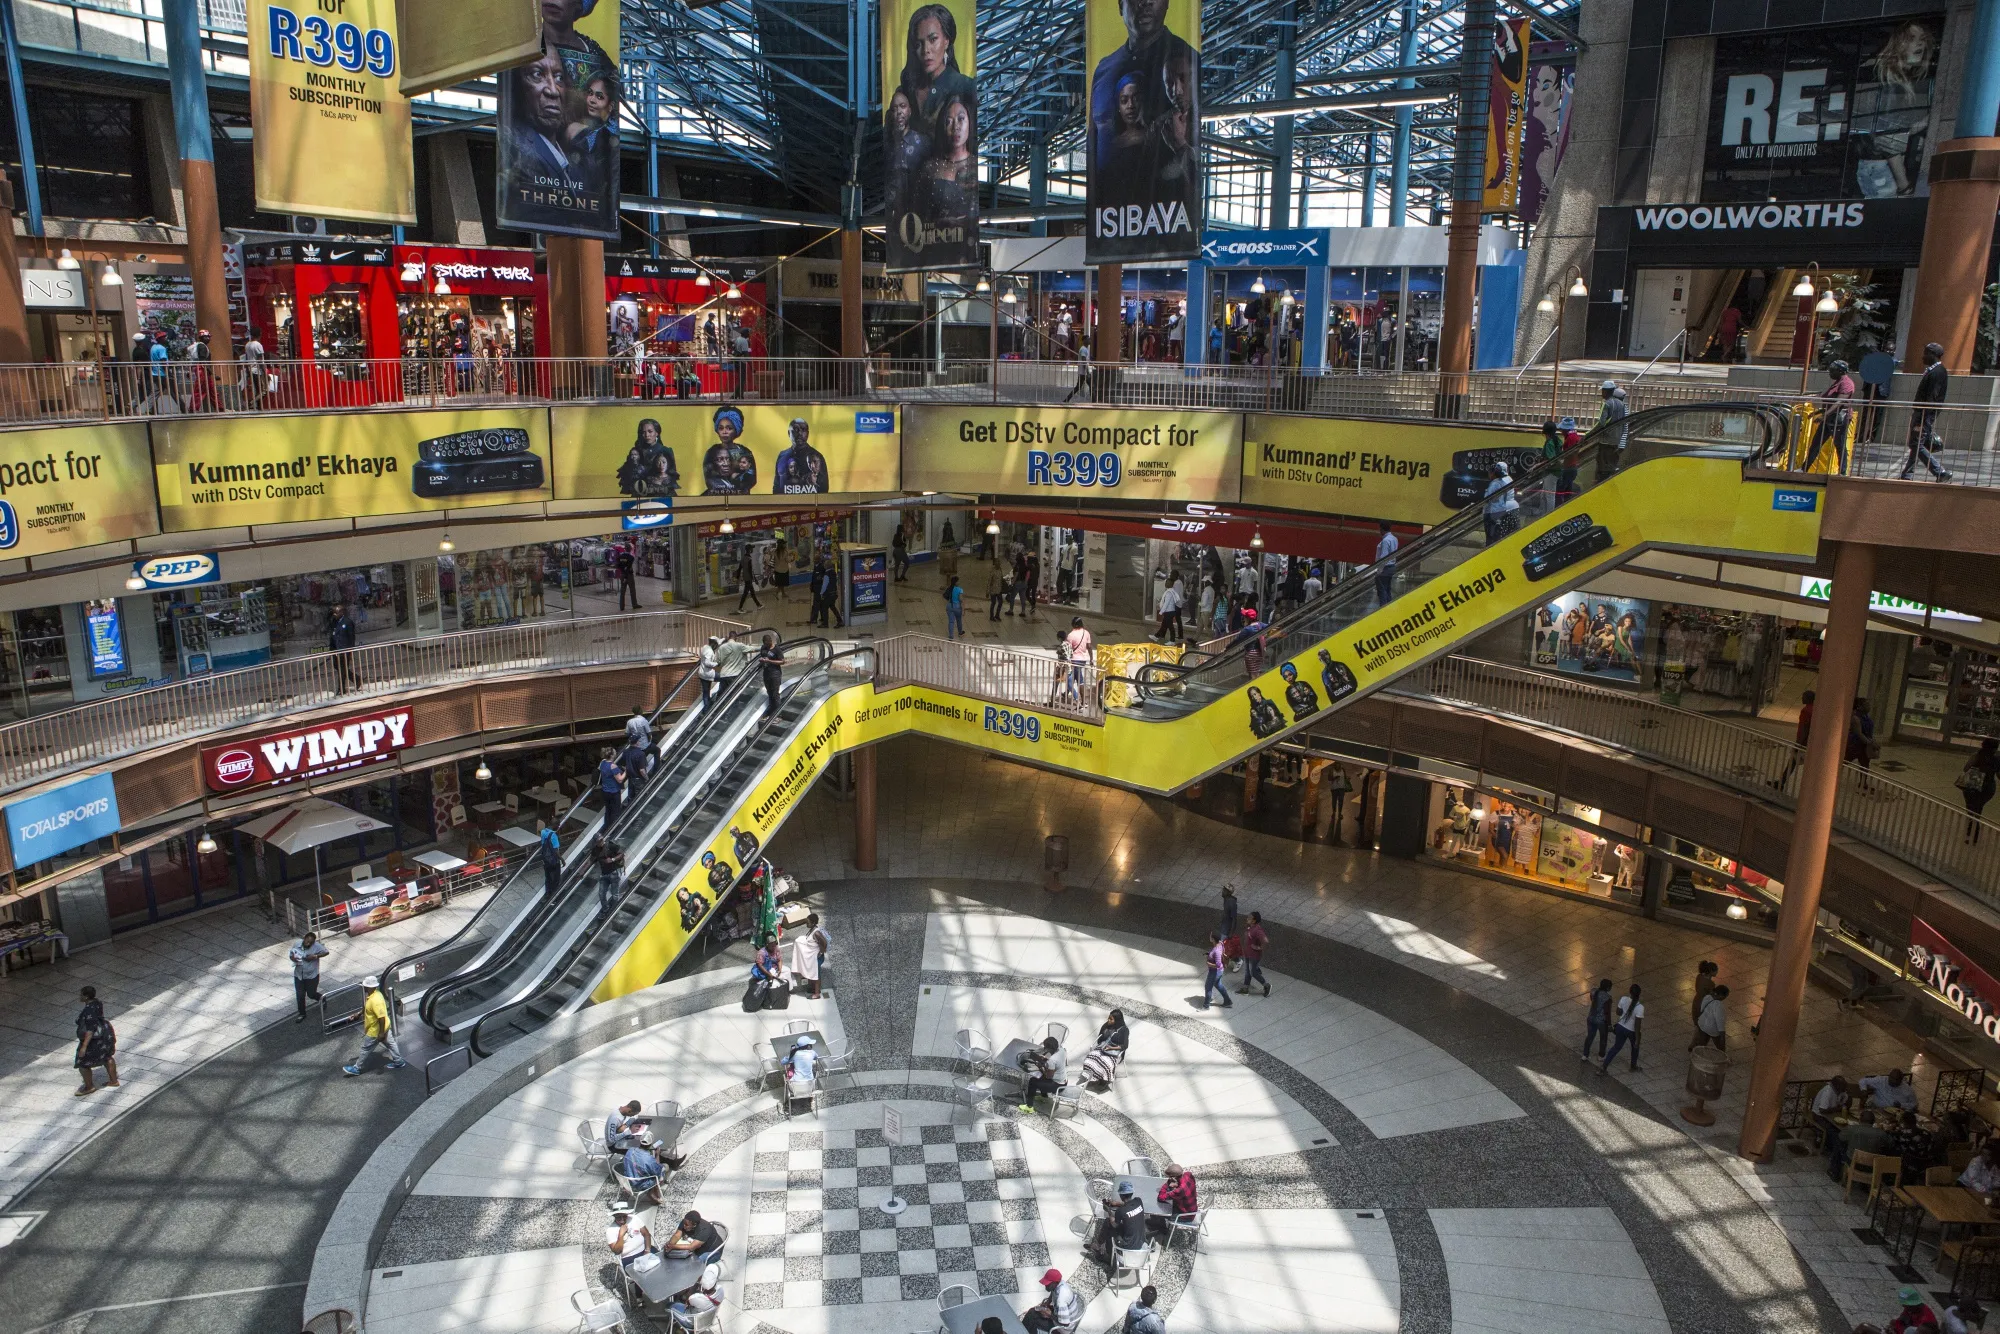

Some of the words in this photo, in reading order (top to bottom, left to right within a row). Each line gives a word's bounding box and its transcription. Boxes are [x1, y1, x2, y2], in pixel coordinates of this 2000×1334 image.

[268, 4, 395, 78] R399
[306, 72, 366, 95] MONTHLY
[289, 86, 382, 114] SUBSCRIPTION
[1512, 91, 1522, 106] go
[320, 109, 337, 119] T&Cs
[337, 112, 358, 122] APPLY
[1507, 107, 1518, 127] the
[1507, 127, 1516, 141] on
[1735, 145, 1754, 160] ONLY
[1755, 145, 1765, 158] AT
[1767, 143, 1818, 158] WOOLWORTHS
[1502, 143, 1517, 184] people
[534, 175, 560, 187] LONG
[563, 179, 584, 190] LIVE
[552, 188, 569, 196] THE
[520, 189, 600, 211] THRONE
[1499, 184, 1511, 208] For
[1095, 200, 1192, 239] ISIBAYA
[1635, 202, 1865, 231] WOOLWORTHS
[900, 212, 964, 254] Queen
[1228, 242, 1273, 255] CROSS
[1273, 244, 1297, 252] TRAINER
[434, 262, 488, 279] STREET
[643, 265, 659, 273] FILA
[670, 266, 697, 275] CONVERSE
[808, 272, 838, 288] THE
[860, 416, 890, 425] DStv
[959, 420, 997, 443] Get
[1005, 421, 1056, 444] DStv
[1063, 422, 1160, 450] Compact
[1168, 424, 1199, 447] for
[65, 450, 101, 480] for
[189, 456, 311, 485] Kumnand'
[317, 454, 398, 478] Ekhaya
[1027, 450, 1122, 487] R399
[1137, 461, 1168, 469] MONTHLY
[1263, 443, 1356, 470] Kumnand'
[1360, 453, 1430, 480] Ekhaya
[1128, 469, 1177, 478] SUBSCRIPTION
[1262, 466, 1285, 480] with
[1287, 468, 1312, 483] DStv
[1315, 472, 1362, 489] Compact
[192, 488, 224, 504] with
[229, 487, 261, 501] DStv
[265, 482, 325, 499] Compact
[784, 484, 818, 494] ISIBAYA
[1778, 494, 1812, 503] DStv
[36, 502, 74, 515] MONTHLY
[27, 512, 86, 529] SUBSCRIPTION
[1151, 518, 1206, 532] STEP
[1353, 602, 1437, 659] Kumnand'
[1440, 567, 1507, 613] Ekhaya
[1364, 652, 1387, 673] with
[1387, 642, 1411, 660] DStv
[1411, 616, 1457, 648] Compact
[106, 680, 122, 691] Best
[123, 676, 147, 688] prices
[1333, 684, 1353, 697] ISIBAYA
[854, 709, 870, 724] Get
[872, 704, 892, 721] over
[894, 696, 912, 712] 100
[913, 699, 961, 720] channels
[963, 708, 978, 723] for
[983, 703, 1041, 743] R399
[1053, 722, 1085, 736] MONTHLY
[260, 712, 409, 775] WIMPY
[1044, 730, 1093, 749] SUBSCRIPTION
[217, 758, 253, 775] WIMPY
[752, 755, 804, 824] Kumnand'
[804, 714, 844, 761] Ekhaya
[760, 813, 776, 832] with
[775, 796, 791, 814] DStv
[789, 763, 817, 796] Compact
[20, 797, 109, 842] TOTALSPORTS
[353, 901, 374, 911] Under
[374, 896, 388, 905] R30
